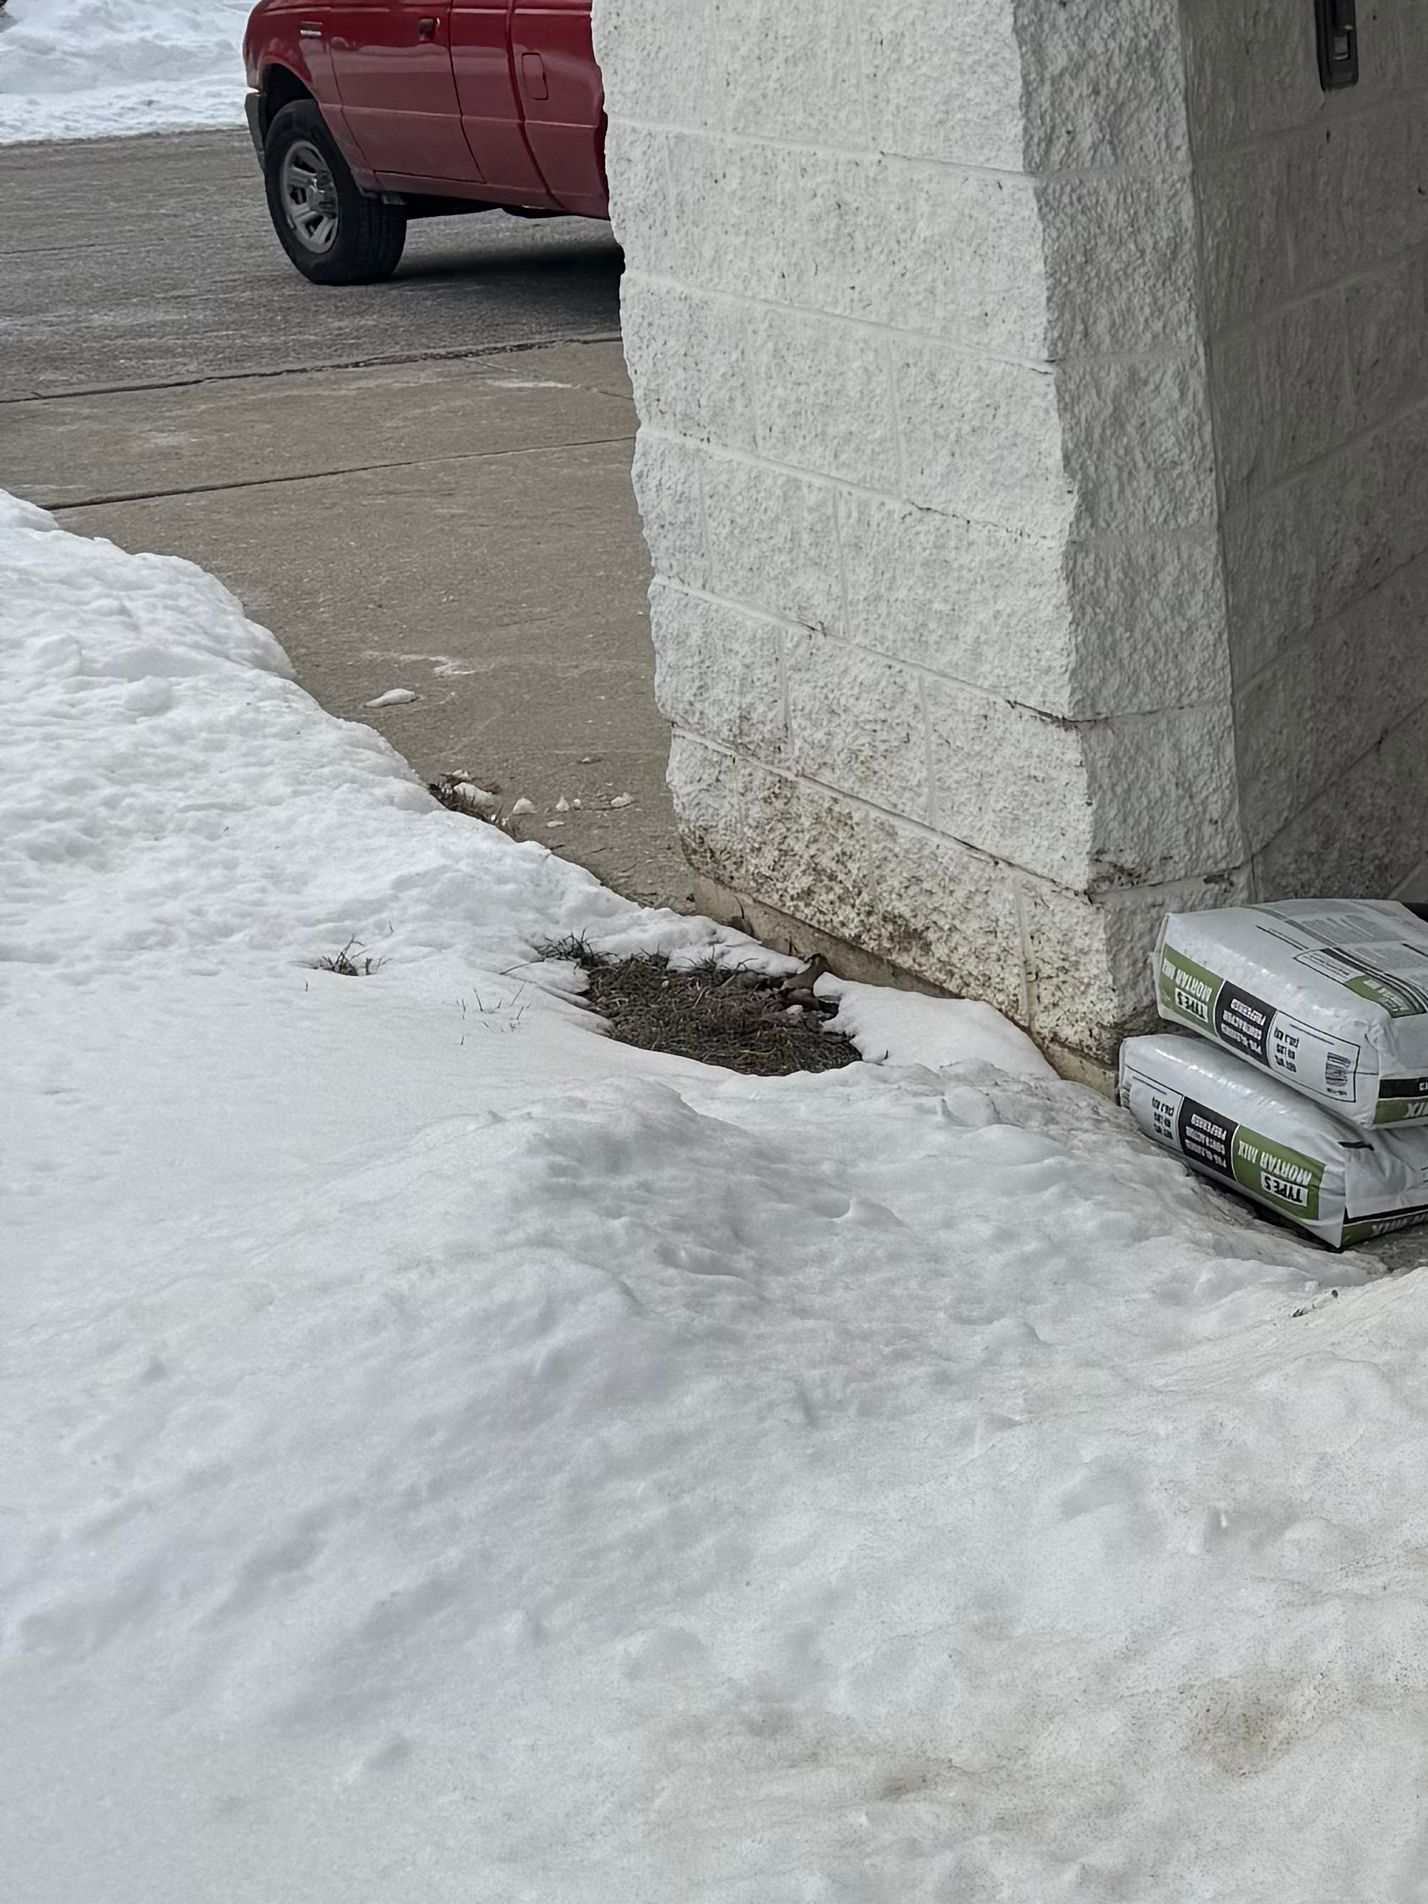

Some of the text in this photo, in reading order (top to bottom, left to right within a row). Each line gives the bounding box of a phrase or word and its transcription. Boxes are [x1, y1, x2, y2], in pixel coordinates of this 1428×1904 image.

[1175, 968, 1212, 1002] MORTAR
[1238, 1140, 1312, 1186] MORTAR MIX
[1273, 1180, 1303, 1203] TYPE
